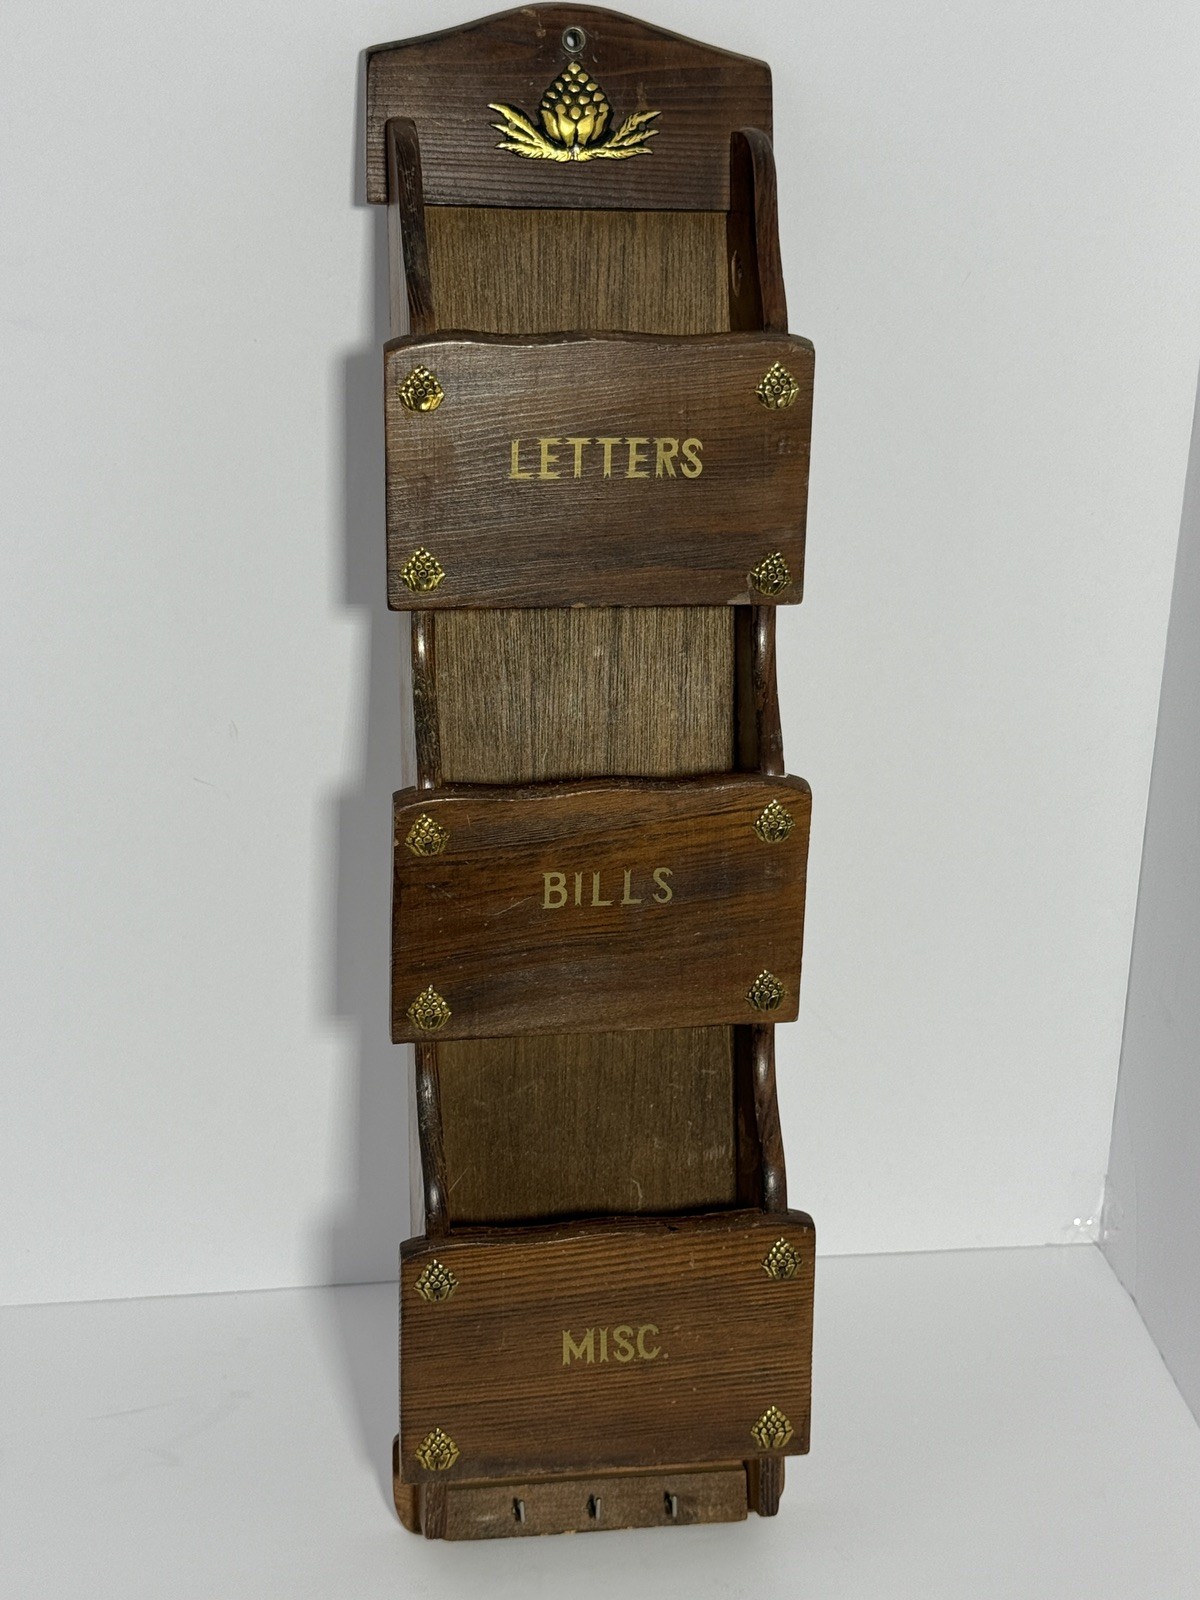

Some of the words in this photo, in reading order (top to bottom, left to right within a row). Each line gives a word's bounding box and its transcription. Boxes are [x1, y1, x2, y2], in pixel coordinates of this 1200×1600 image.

[508, 437, 704, 479] LETTERS
[541, 867, 673, 909] BILLS
[562, 1323, 669, 1366] MISC.
